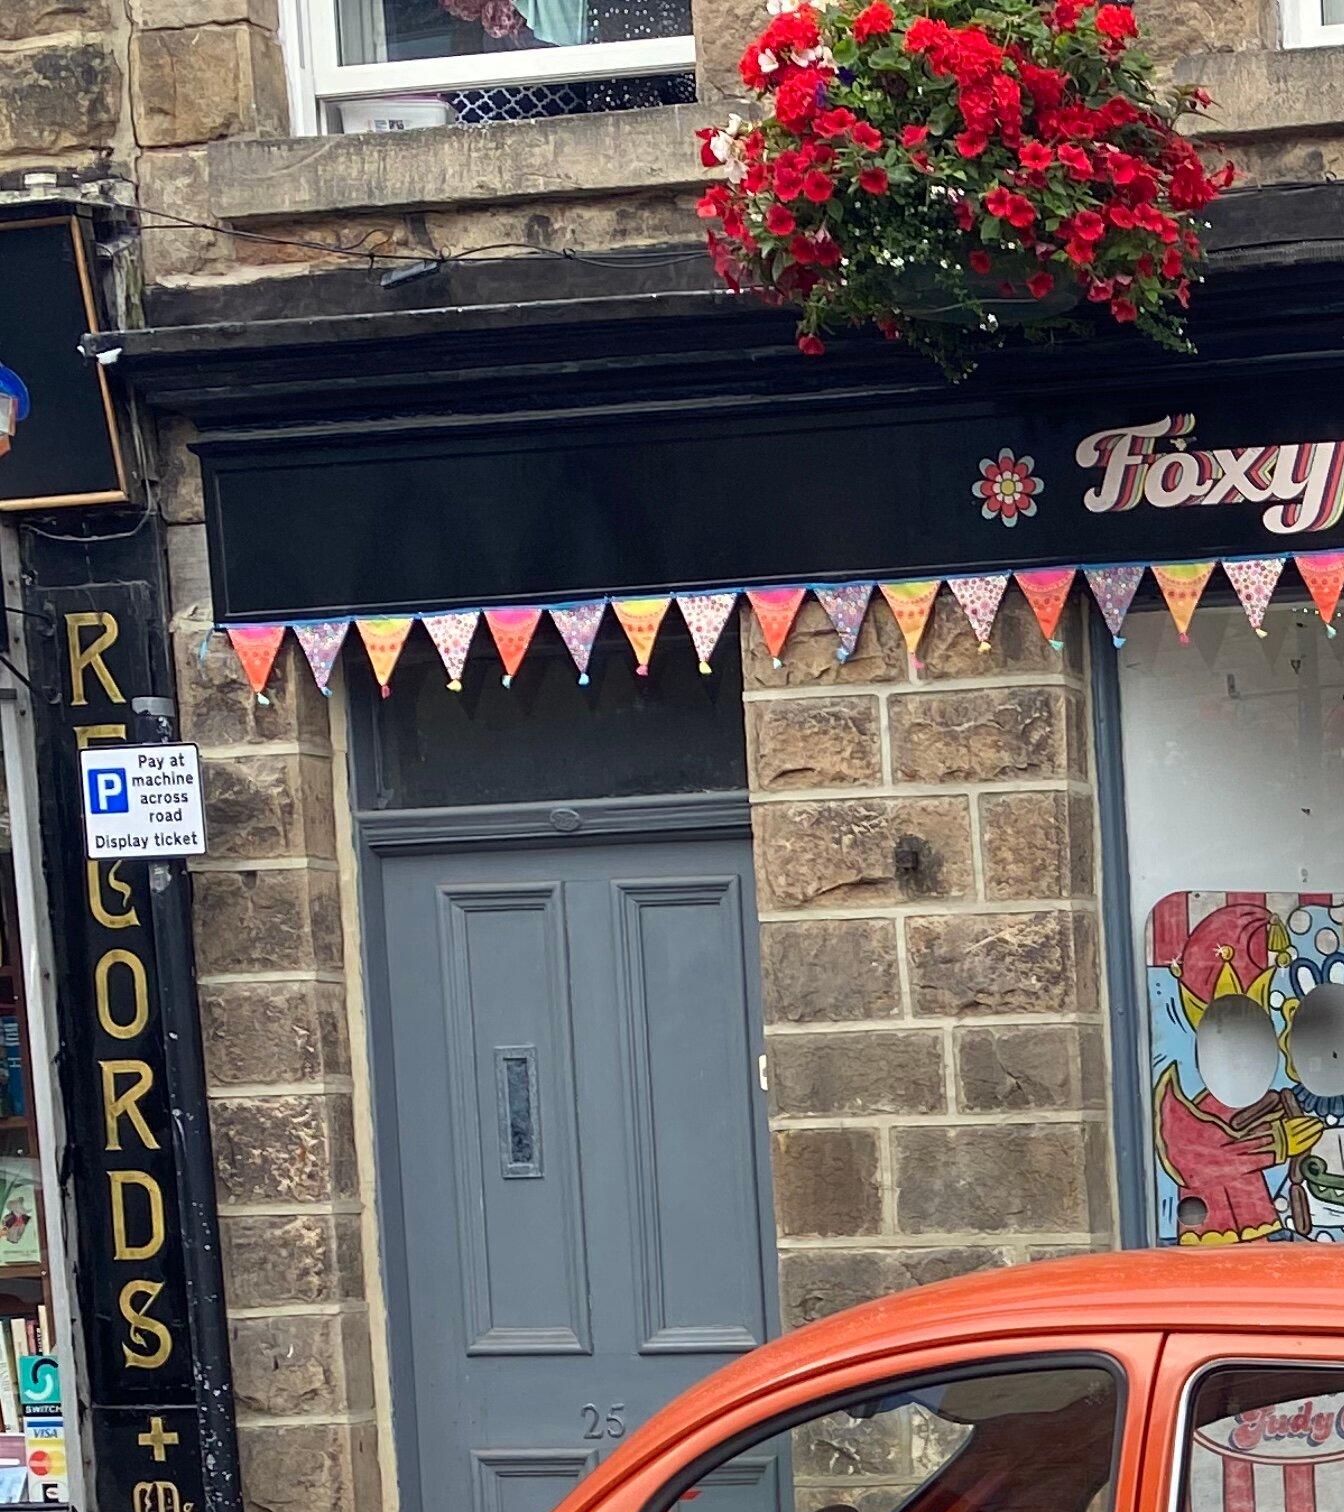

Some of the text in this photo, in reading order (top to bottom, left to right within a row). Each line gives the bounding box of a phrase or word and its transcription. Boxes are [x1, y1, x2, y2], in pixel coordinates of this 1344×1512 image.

[138, 753, 185, 770] Pay at
[131, 771, 194, 787] machine
[140, 791, 189, 805] across
[149, 808, 183, 823] road
[95, 831, 198, 850] Display ticket
[63, 611, 174, 1369] RCORDS
[25, 1404, 62, 1414] SWITCH
[581, 1403, 626, 1439] 25
[33, 1428, 58, 1439] VISA
